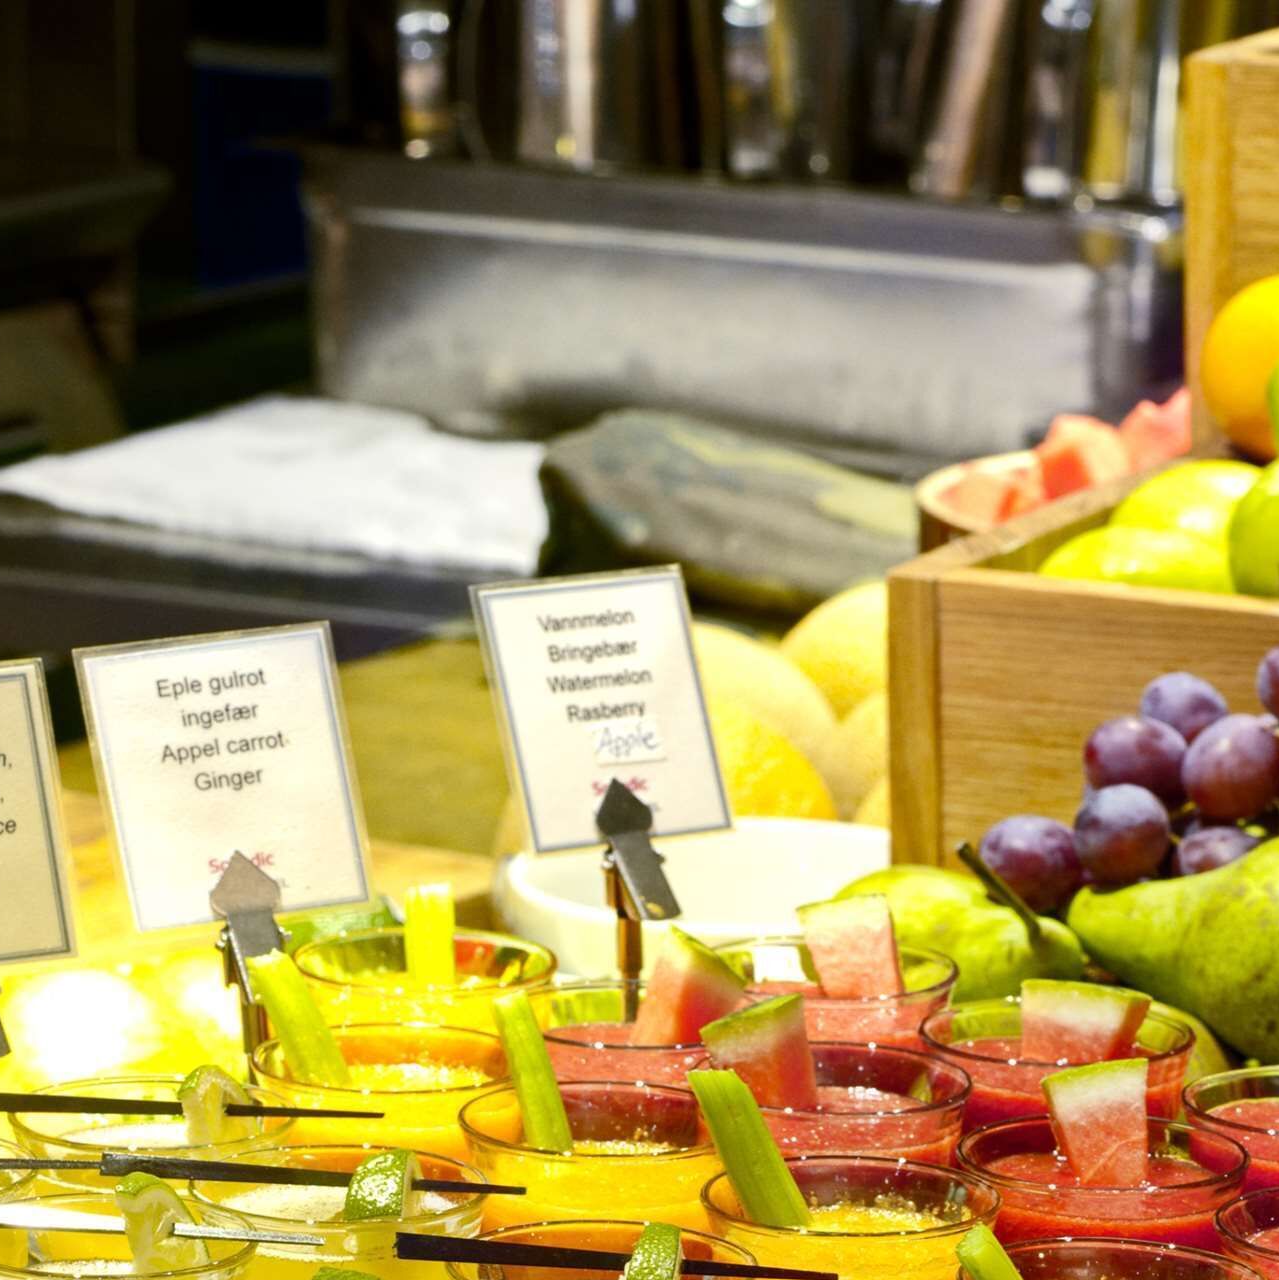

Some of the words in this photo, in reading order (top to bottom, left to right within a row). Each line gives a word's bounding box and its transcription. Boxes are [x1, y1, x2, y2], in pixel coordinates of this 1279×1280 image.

[538, 609, 635, 632] Vannmelon
[156, 675, 202, 700] Eple
[209, 668, 266, 695] gulrot
[547, 669, 653, 693] Watermelon
[182, 702, 259, 729] ingefær
[567, 702, 646, 723] Rasberry
[161, 740, 220, 764] Appel
[227, 731, 285, 754] carrot
[596, 722, 658, 757] Apple
[194, 768, 263, 792] Ginger
[208, 851, 274, 874] Scdic
